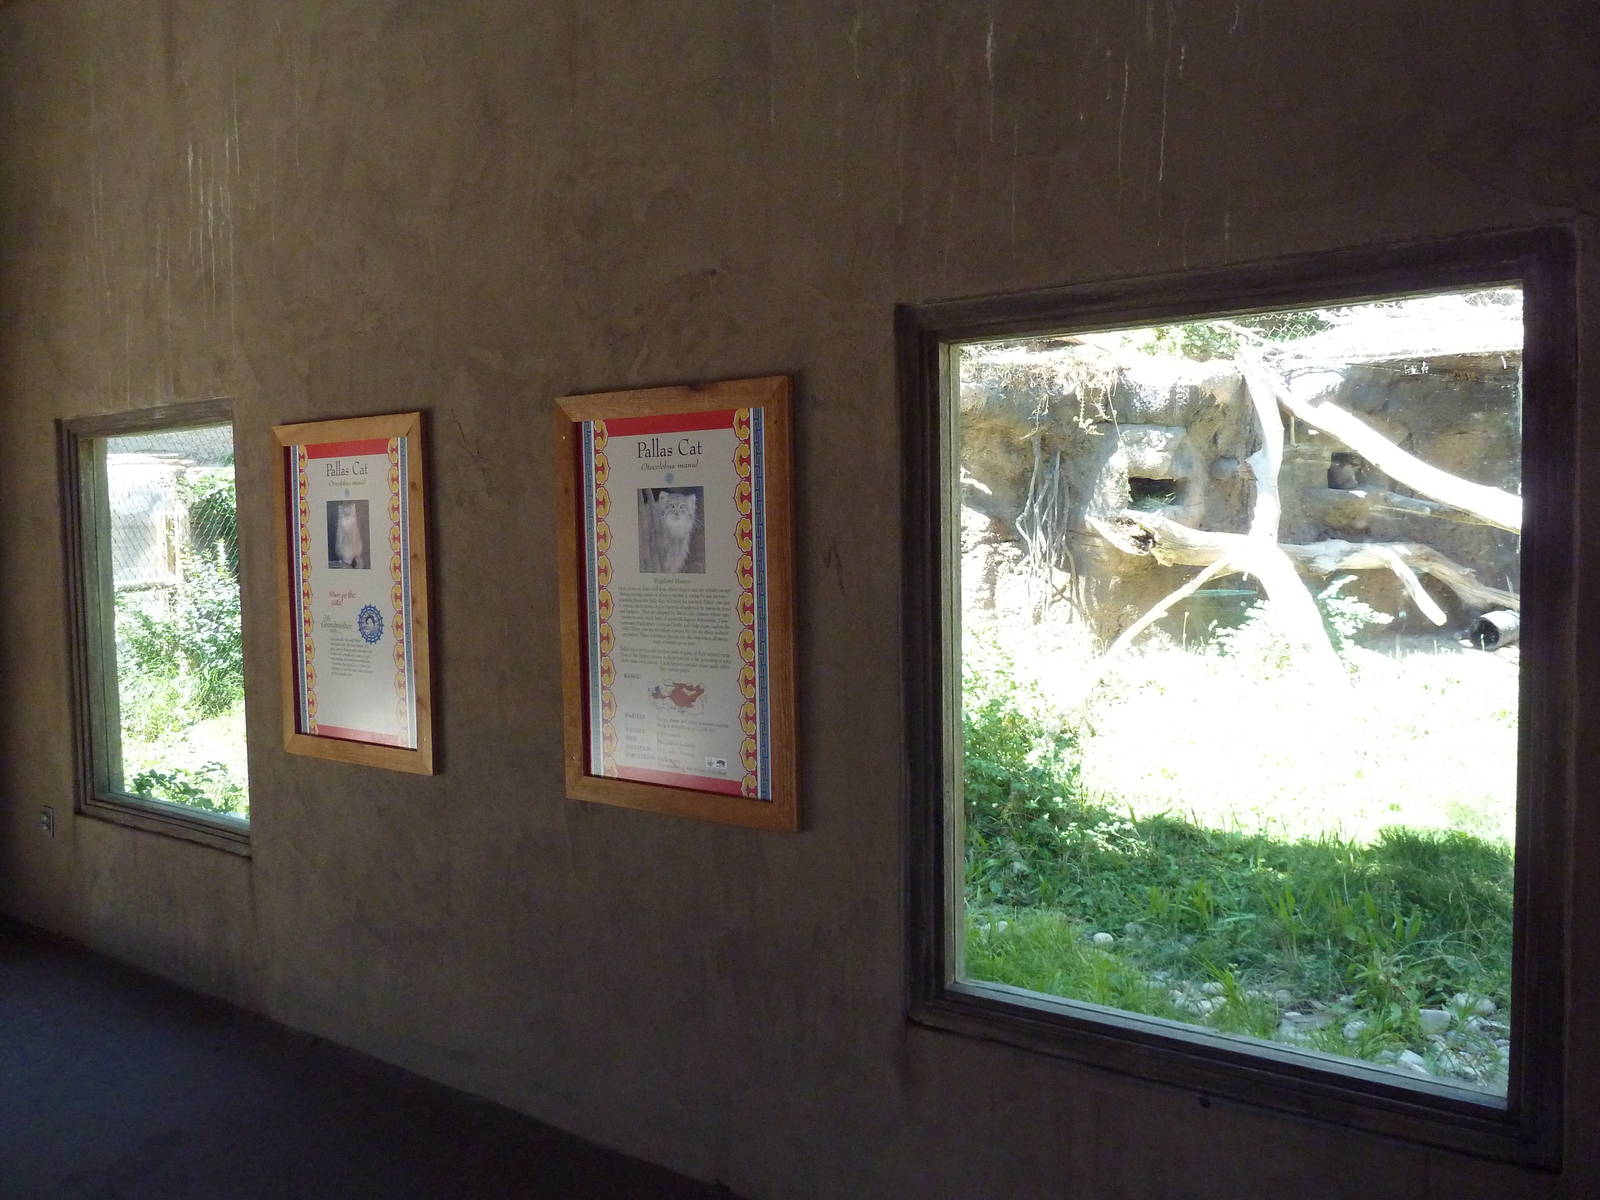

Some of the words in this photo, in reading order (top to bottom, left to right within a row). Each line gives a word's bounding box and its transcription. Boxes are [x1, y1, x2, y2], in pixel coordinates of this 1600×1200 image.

[637, 438, 673, 458] Pallas
[677, 438, 703, 456] Cat
[326, 460, 350, 477] Pallas
[352, 461, 369, 476] Cat
